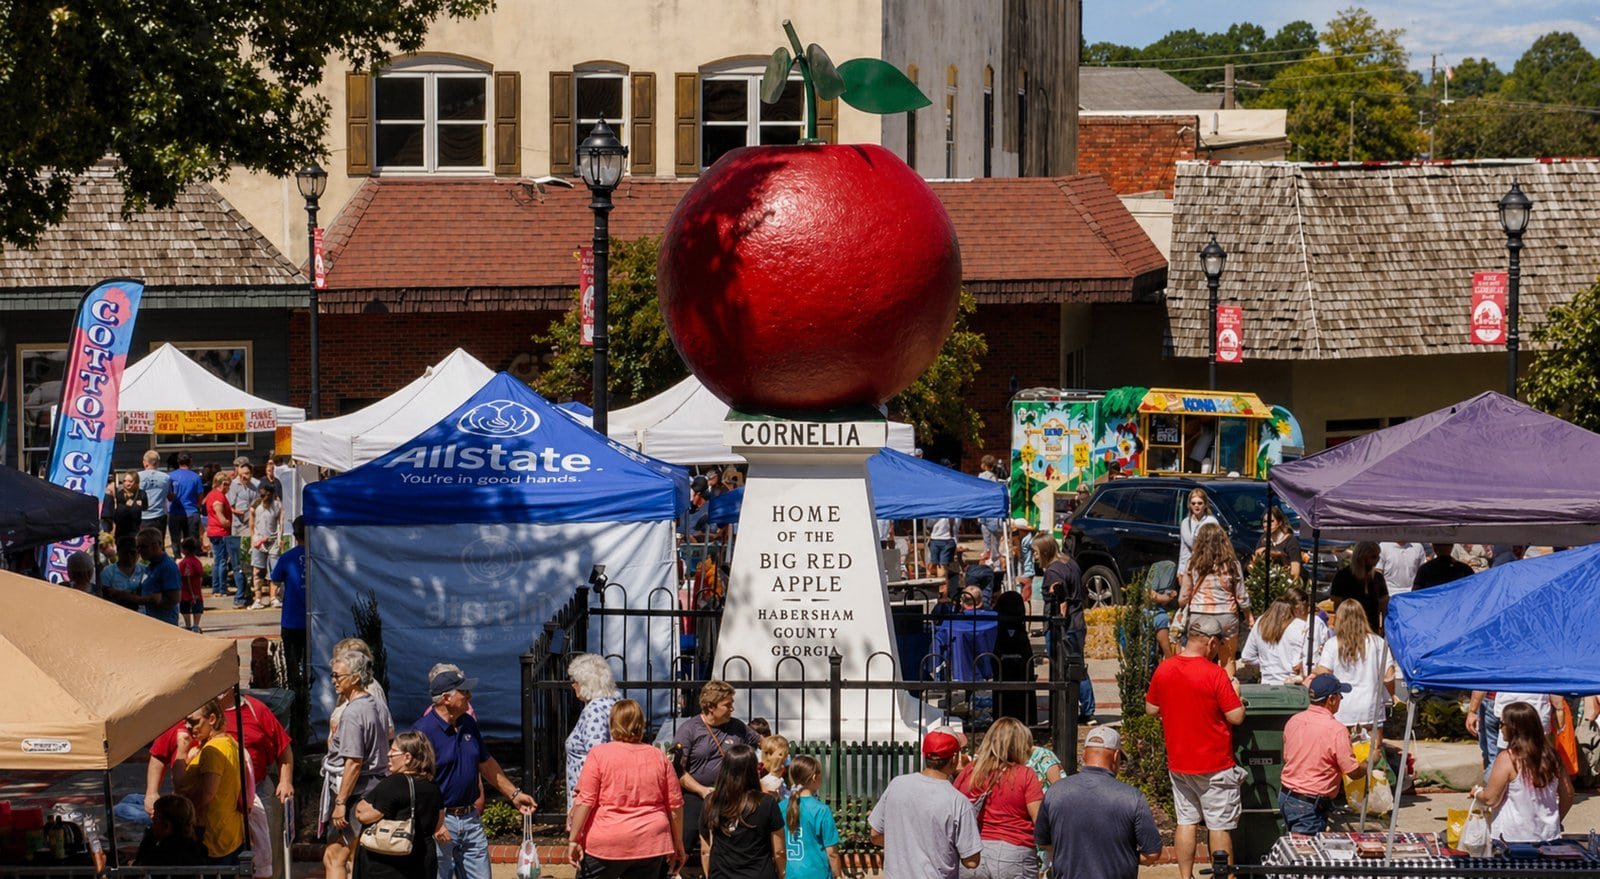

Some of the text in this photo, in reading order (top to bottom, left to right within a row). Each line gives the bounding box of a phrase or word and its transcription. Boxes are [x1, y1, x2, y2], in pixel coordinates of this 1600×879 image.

[68, 299, 119, 443] COTTON
[741, 423, 860, 446] CORNELIA
[383, 444, 591, 473] Allstate
[400, 473, 581, 485] You're in good hands.
[772, 505, 840, 522] HOME
[777, 531, 834, 542] OF THE
[760, 553, 852, 569] BIG RED
[771, 576, 842, 592] APPLE
[758, 609, 854, 620] HABERSHAM
[771, 645, 839, 657] GEORGIA
